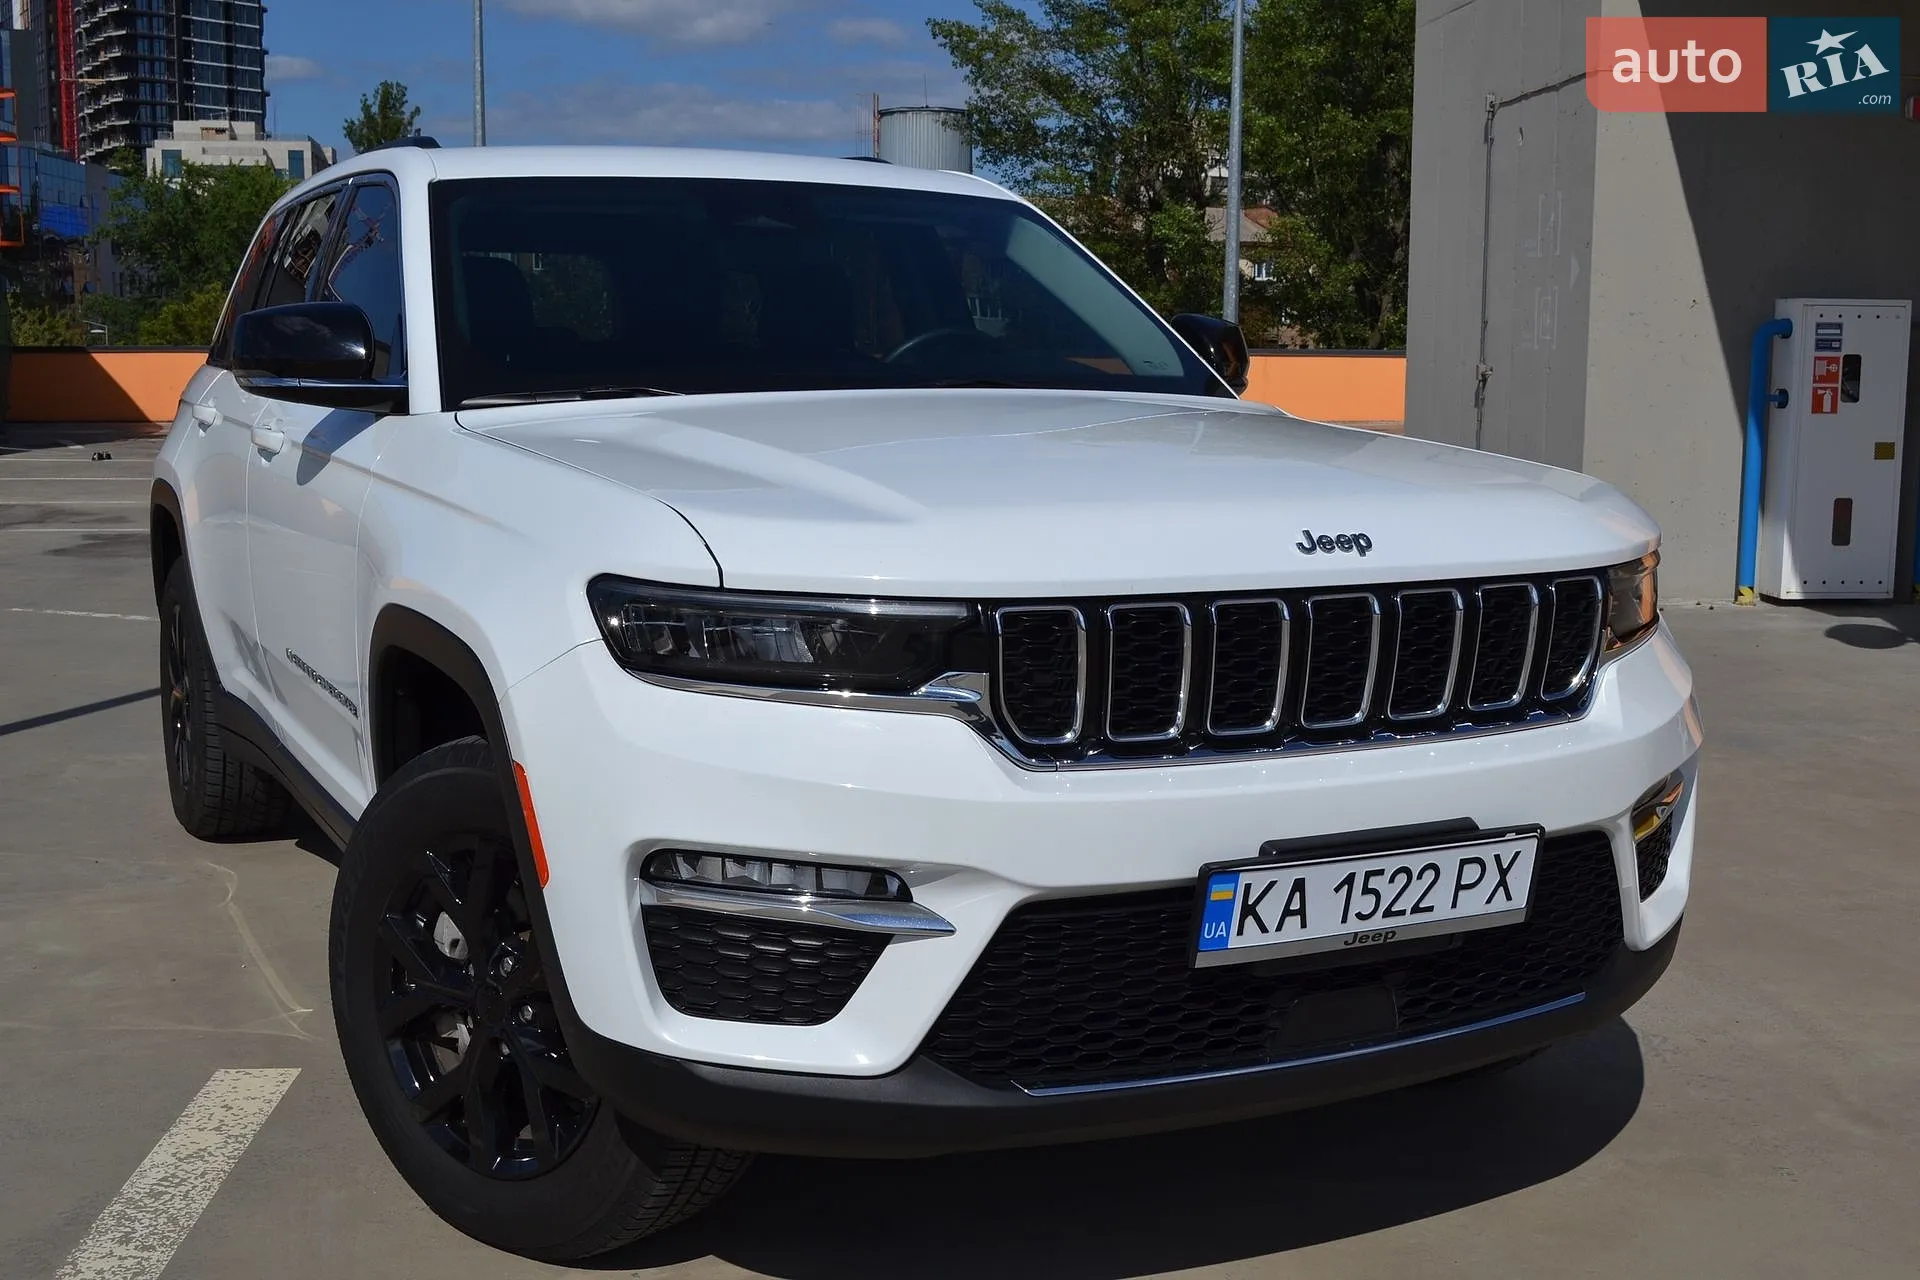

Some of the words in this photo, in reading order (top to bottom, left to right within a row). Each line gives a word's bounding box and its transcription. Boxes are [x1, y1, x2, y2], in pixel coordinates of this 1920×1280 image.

[1295, 529, 1373, 557] Jeep
[1236, 877, 1308, 937] KA
[1332, 862, 1441, 925] 1522
[1451, 850, 1522, 909] PX
[1203, 921, 1228, 940] UA
[1343, 929, 1397, 947] Jeep
